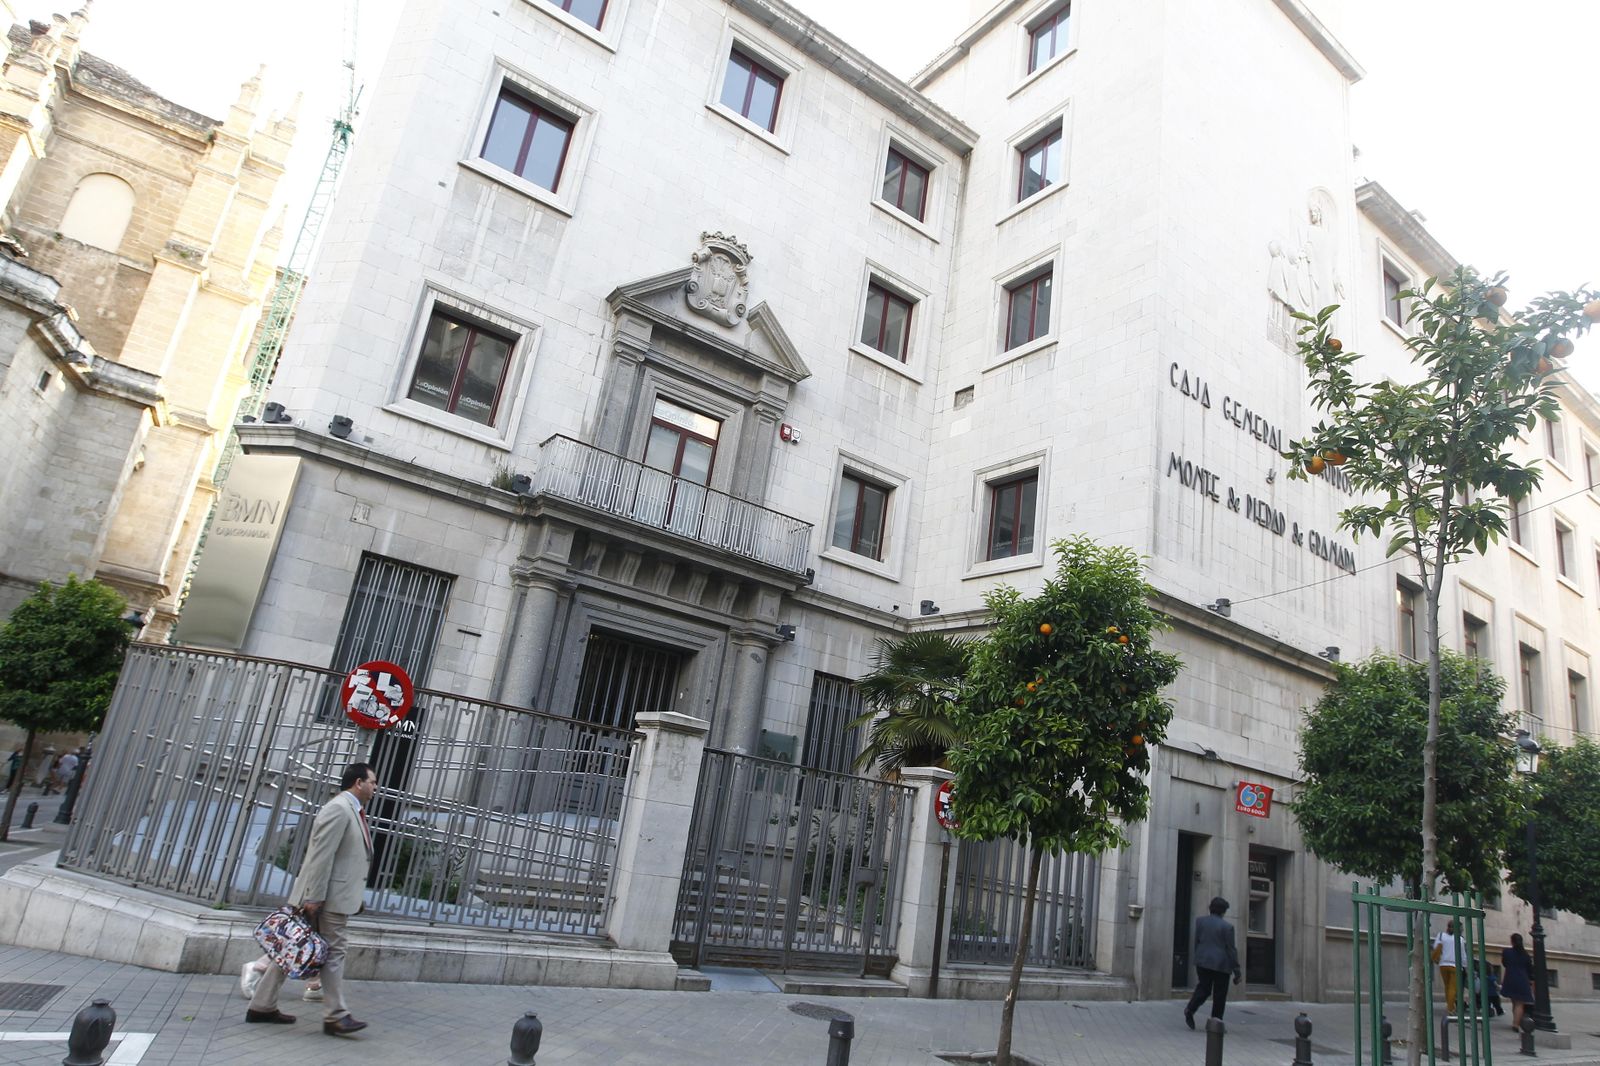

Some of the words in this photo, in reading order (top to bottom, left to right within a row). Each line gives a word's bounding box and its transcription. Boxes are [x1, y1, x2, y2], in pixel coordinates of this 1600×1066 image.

[1170, 362, 1211, 409] CAJA
[1223, 396, 1284, 454] GENERAL
[220, 496, 281, 525] BMN
[1167, 452, 1221, 503] MONTE
[1246, 493, 1286, 537] PIEDAD
[1308, 529, 1357, 576] GRANADA
[1237, 805, 1251, 813] EURO
